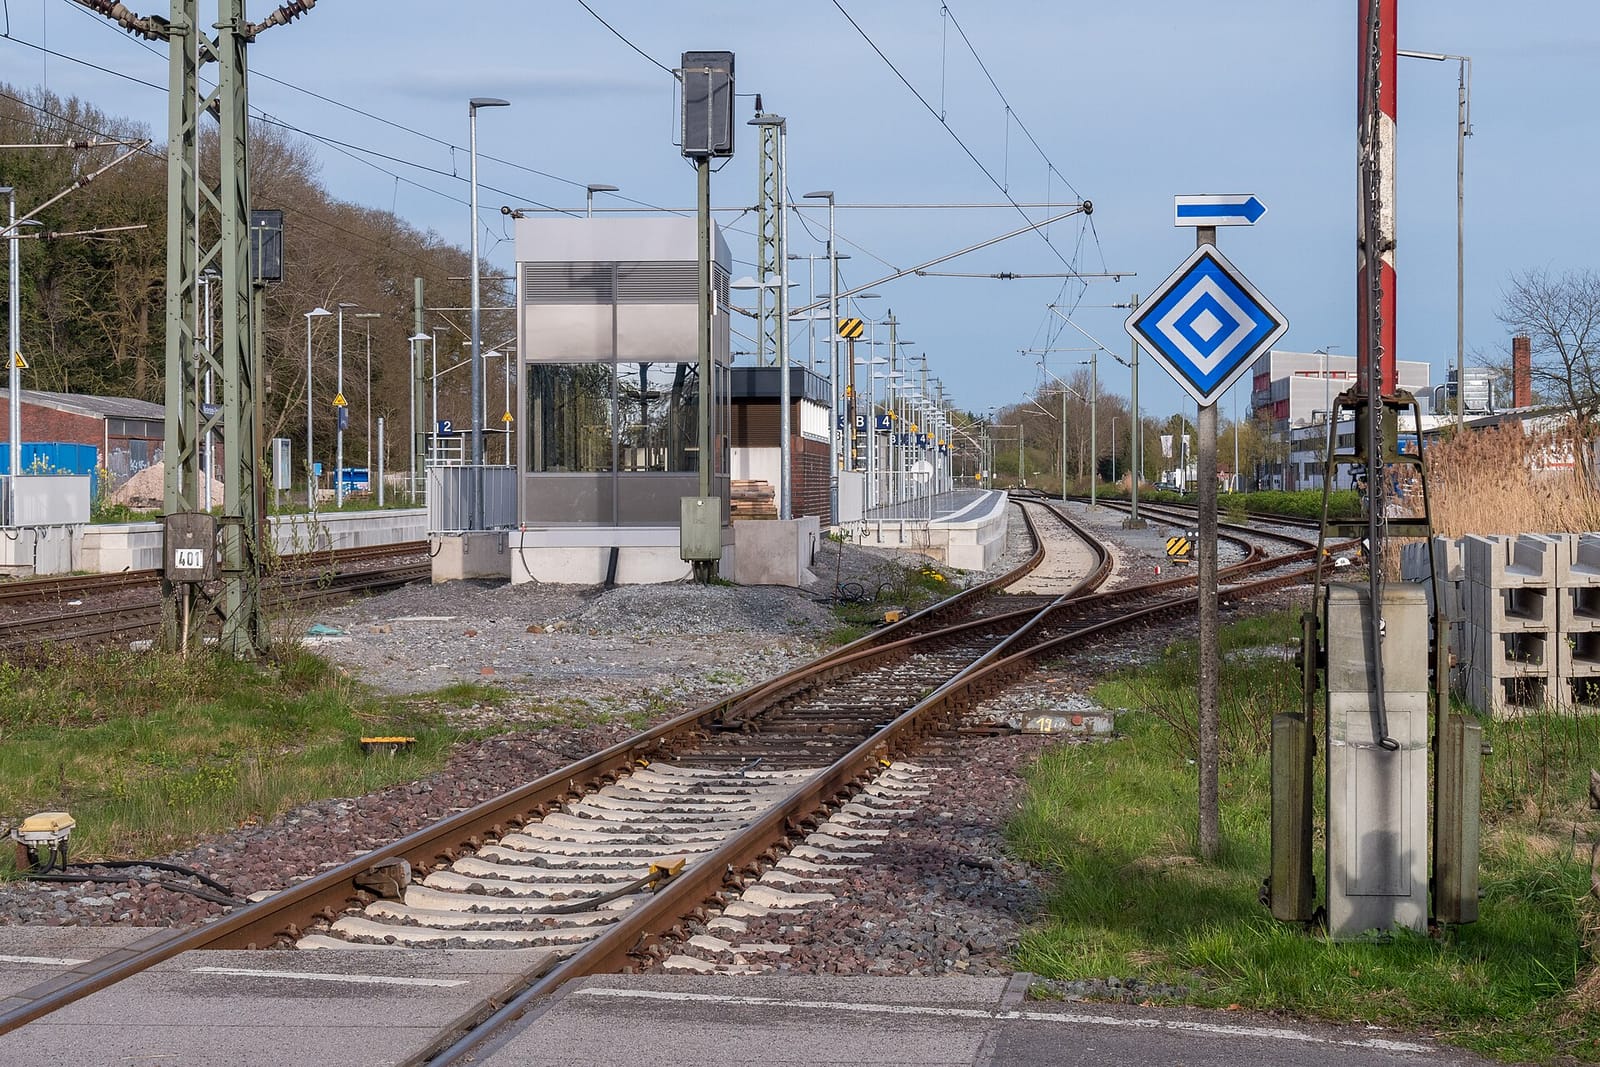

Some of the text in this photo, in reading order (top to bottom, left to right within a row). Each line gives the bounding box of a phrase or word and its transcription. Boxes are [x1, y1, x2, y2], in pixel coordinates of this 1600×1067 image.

[444, 421, 451, 432] 2
[856, 415, 865, 427] B
[882, 415, 890, 427] 4
[179, 551, 199, 566] 401
